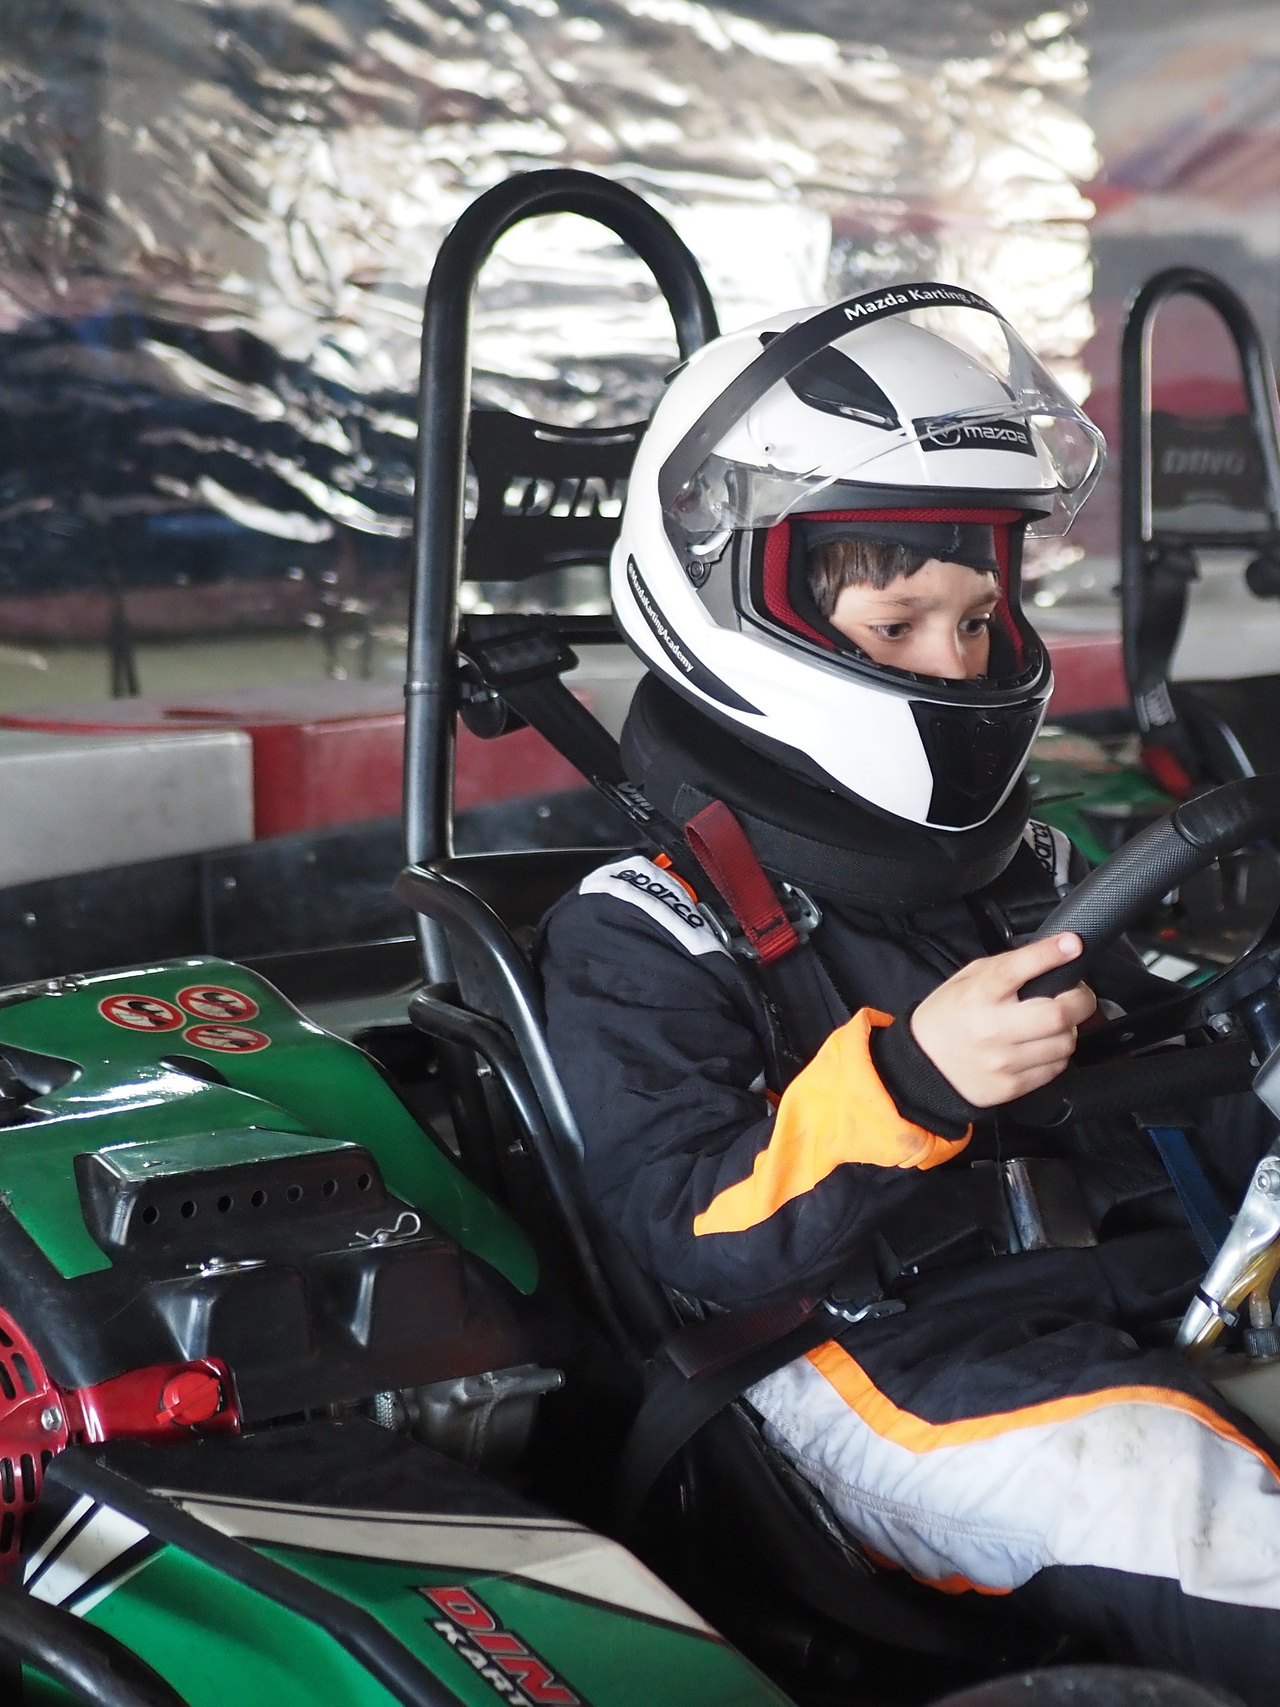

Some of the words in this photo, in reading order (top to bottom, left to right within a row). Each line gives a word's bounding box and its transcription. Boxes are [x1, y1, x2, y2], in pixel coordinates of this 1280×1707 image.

[843, 293, 909, 321] Mazda
[908, 289, 971, 304] Karting
[501, 476, 628, 518] DIN
[420, 1587, 580, 1707] DIN
